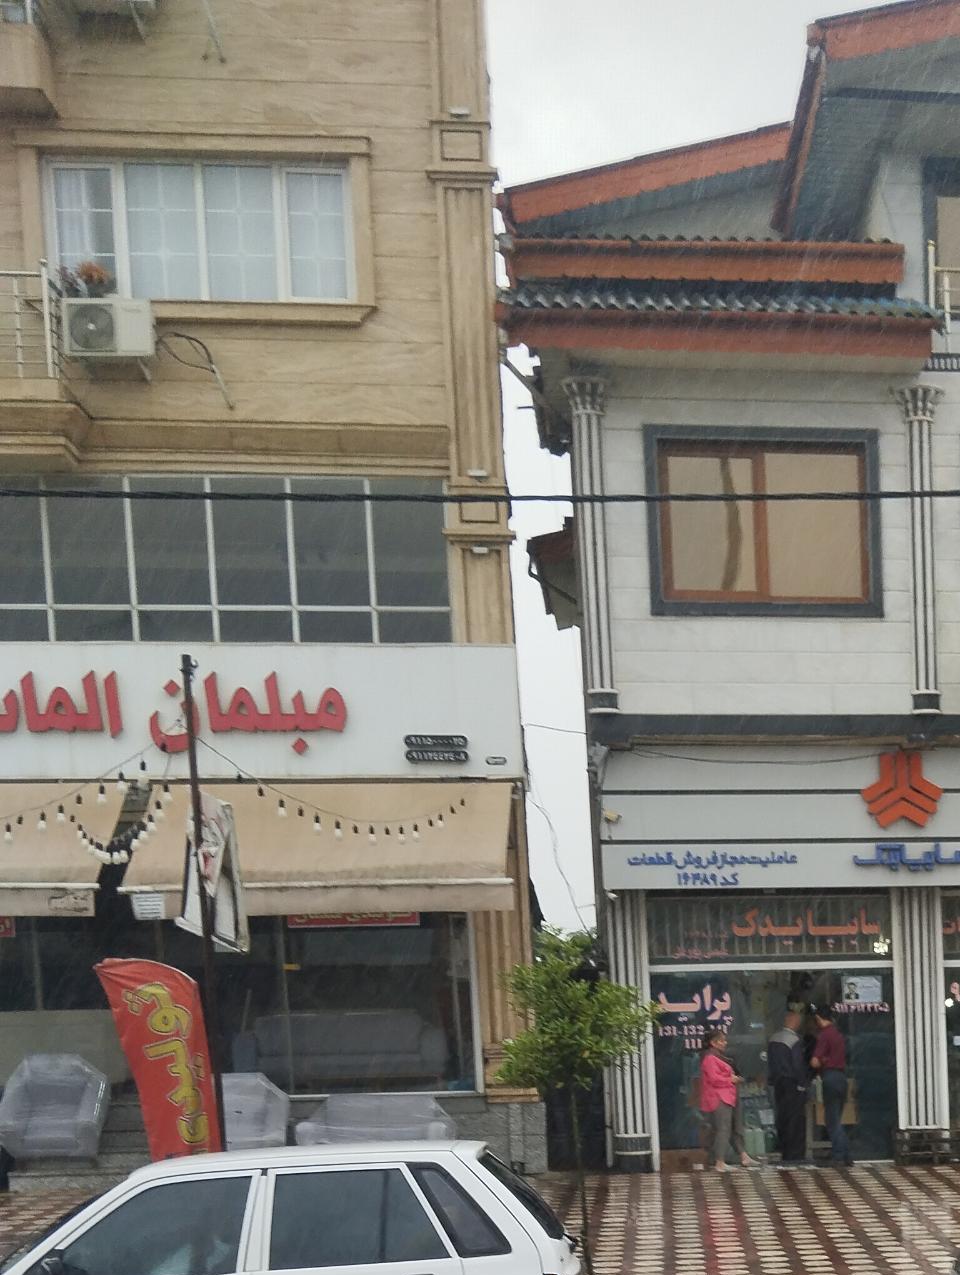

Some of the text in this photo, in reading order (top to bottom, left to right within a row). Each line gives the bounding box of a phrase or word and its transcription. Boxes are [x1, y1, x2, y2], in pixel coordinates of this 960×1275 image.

[149, 671, 347, 755] مبلمان
[627, 851, 675, 867] قطعات
[674, 850, 718, 869] فروش
[746, 851, 798, 867] عاملیت
[719, 872, 739, 887] کد
[658, 983, 735, 1026] پراید
